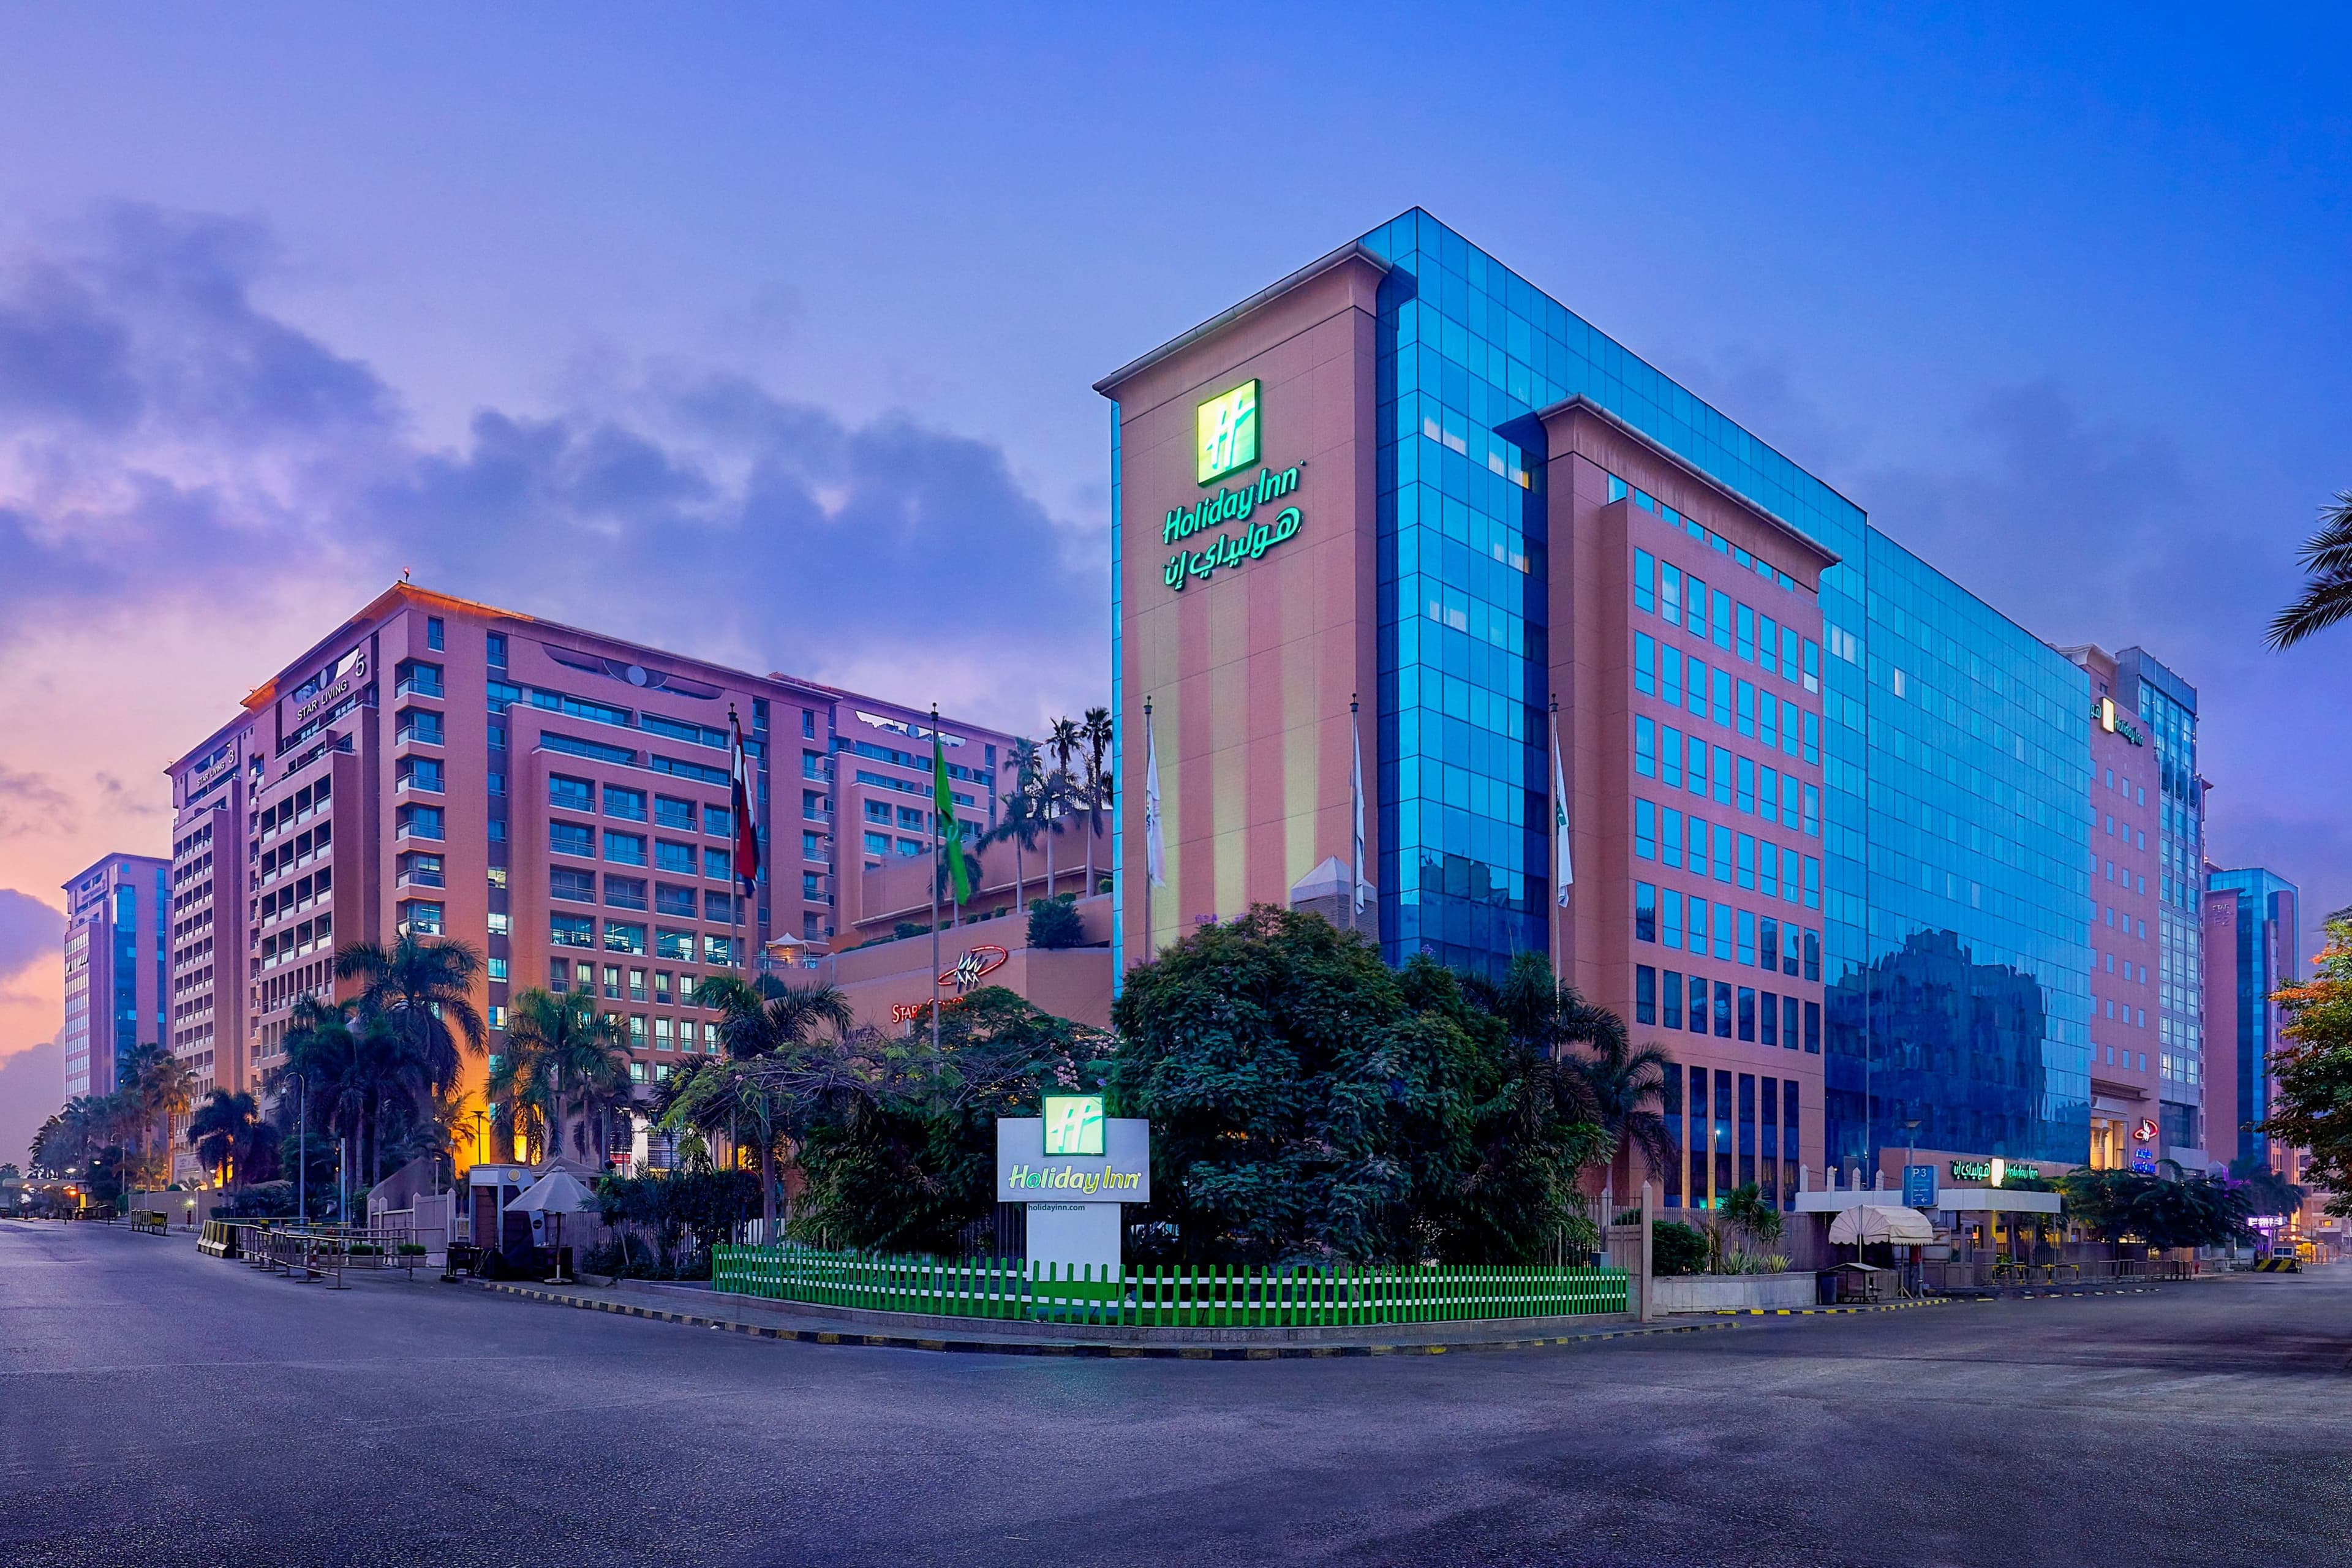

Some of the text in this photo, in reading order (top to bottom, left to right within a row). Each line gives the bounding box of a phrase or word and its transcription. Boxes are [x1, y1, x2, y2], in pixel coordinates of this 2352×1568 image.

[1163, 467, 1299, 545] Holiday Inn
[1188, 506, 1302, 579] هوليداي
[297, 653, 365, 721] STAR LIVING 5
[2114, 714, 2144, 745] Holiday Inn
[197, 749, 234, 786] STAR LIVING 3
[1008, 1164, 1140, 1194] Holiday Inn
[1028, 1203, 1085, 1212] holidayinn.com
